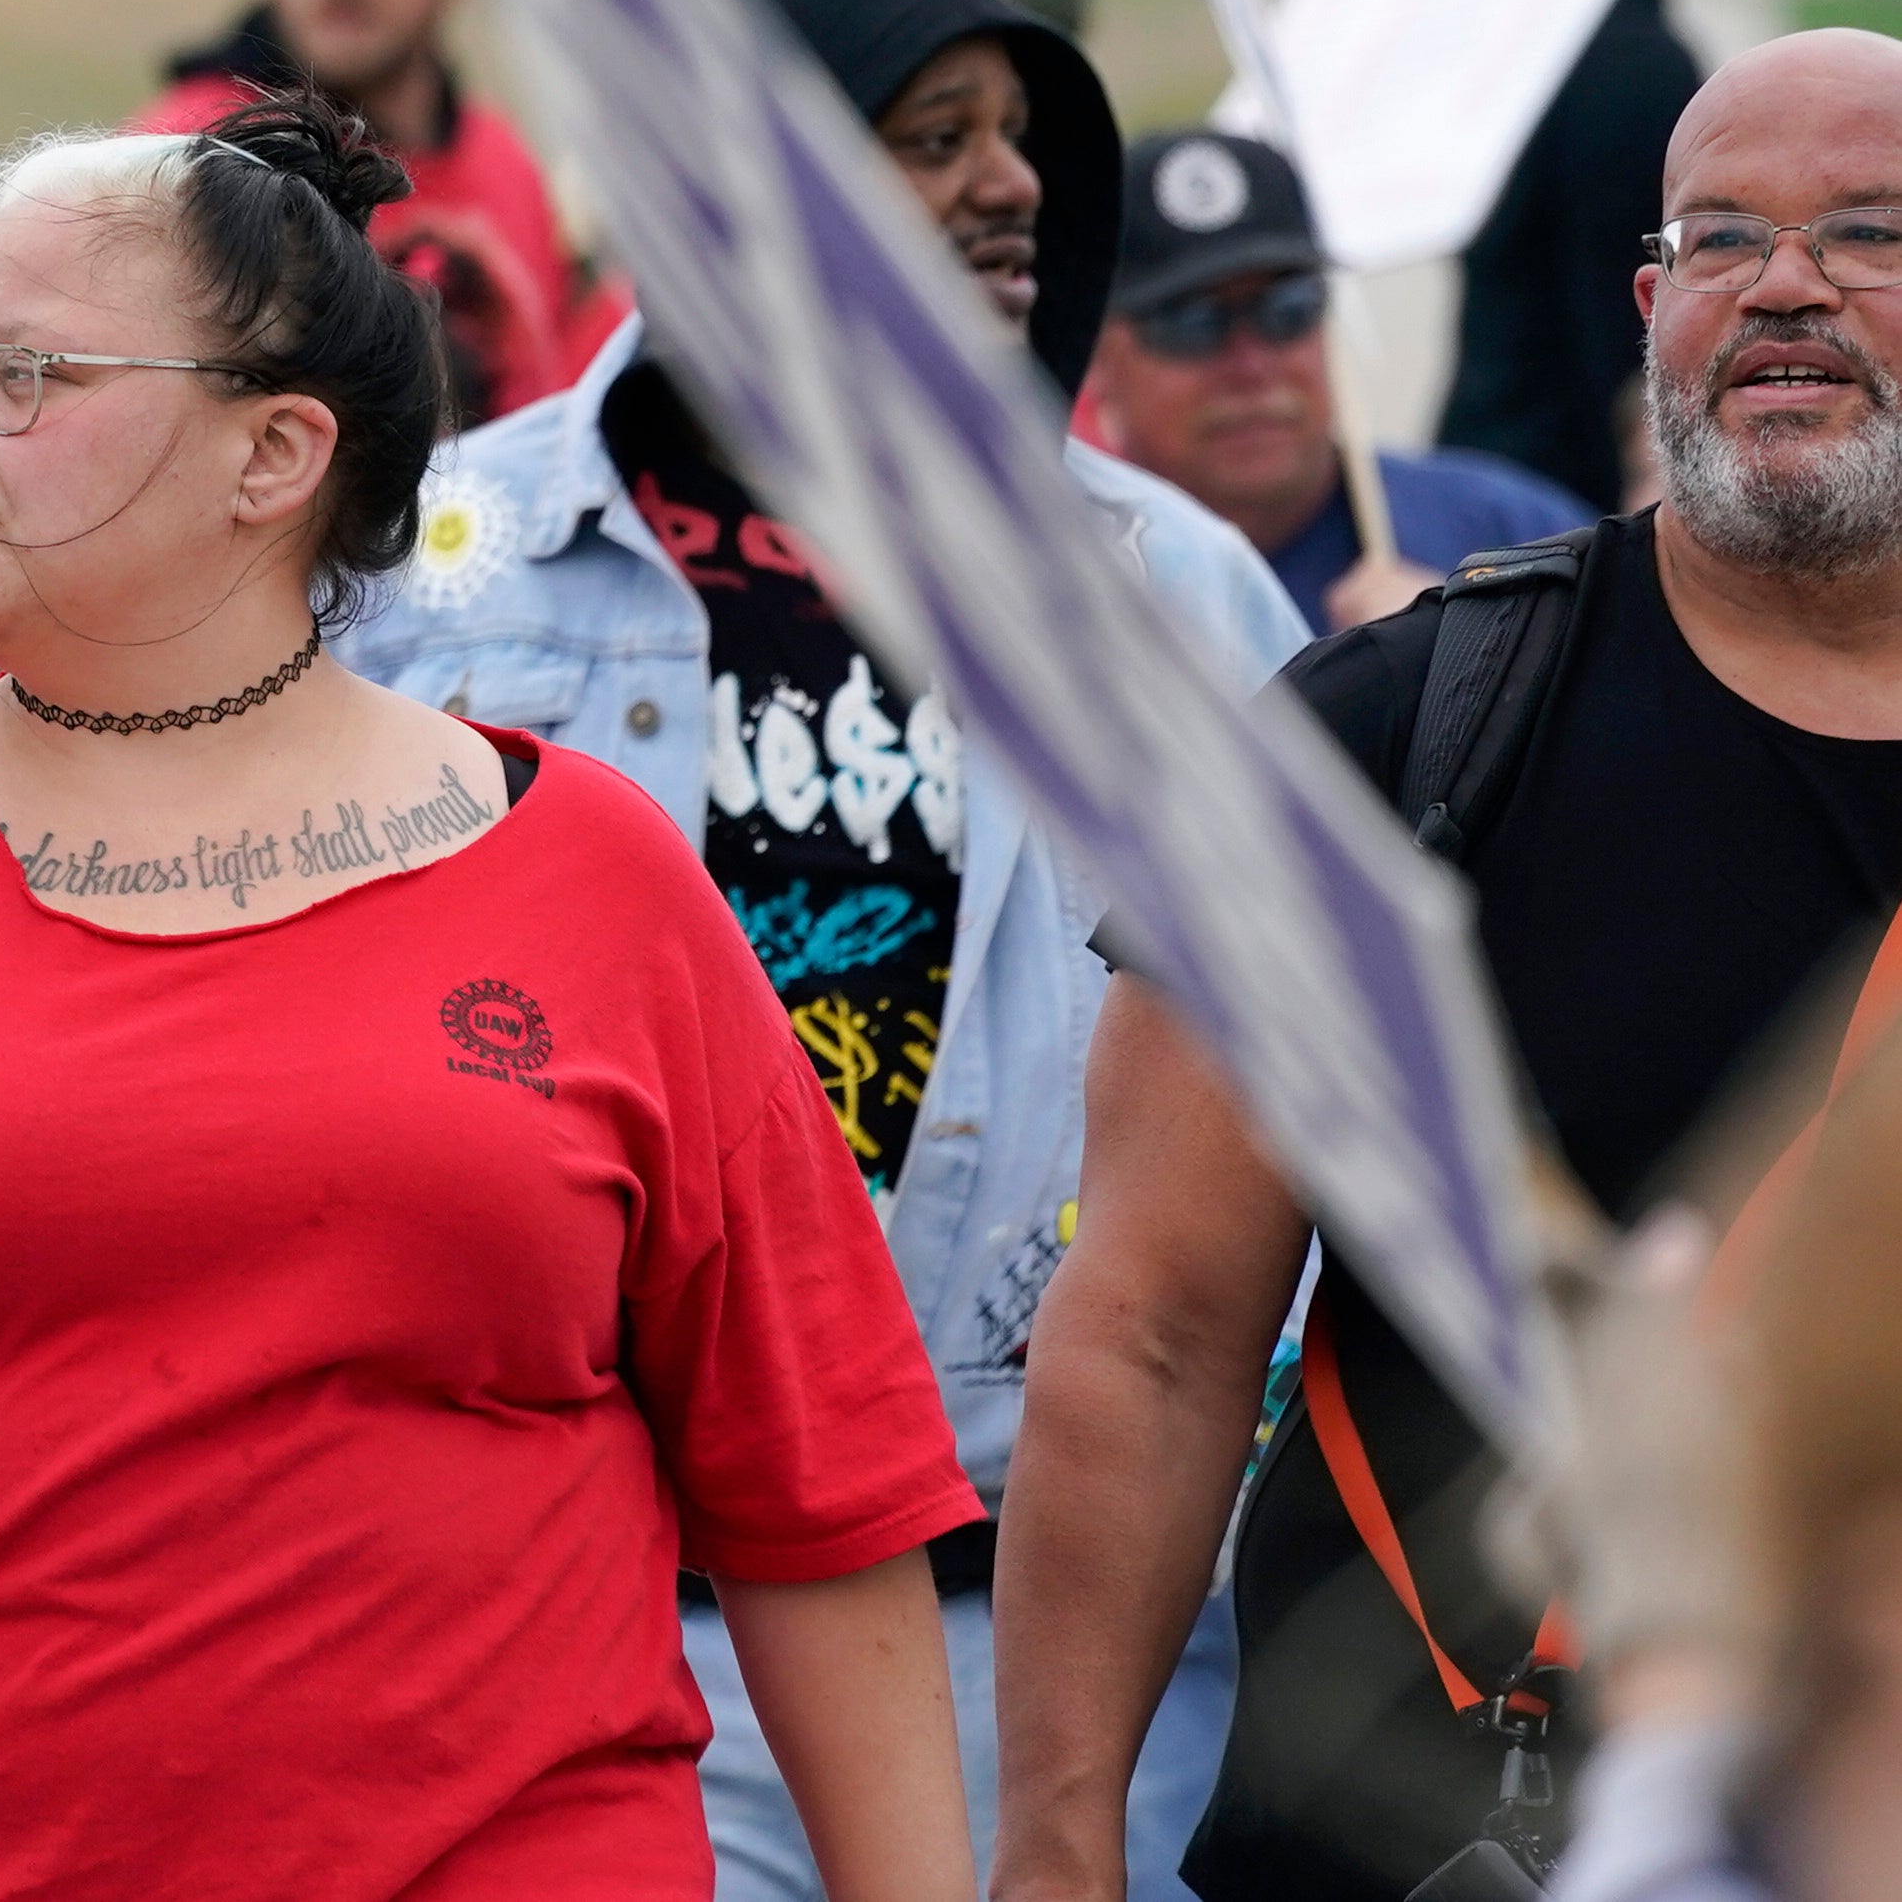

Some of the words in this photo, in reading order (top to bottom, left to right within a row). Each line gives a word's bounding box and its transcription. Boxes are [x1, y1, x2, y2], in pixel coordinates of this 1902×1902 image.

[19, 832, 188, 898] darkness
[193, 829, 283, 909] light
[291, 800, 386, 878] shall
[381, 762, 495, 871] prevail
[474, 1010, 523, 1041] UAW
